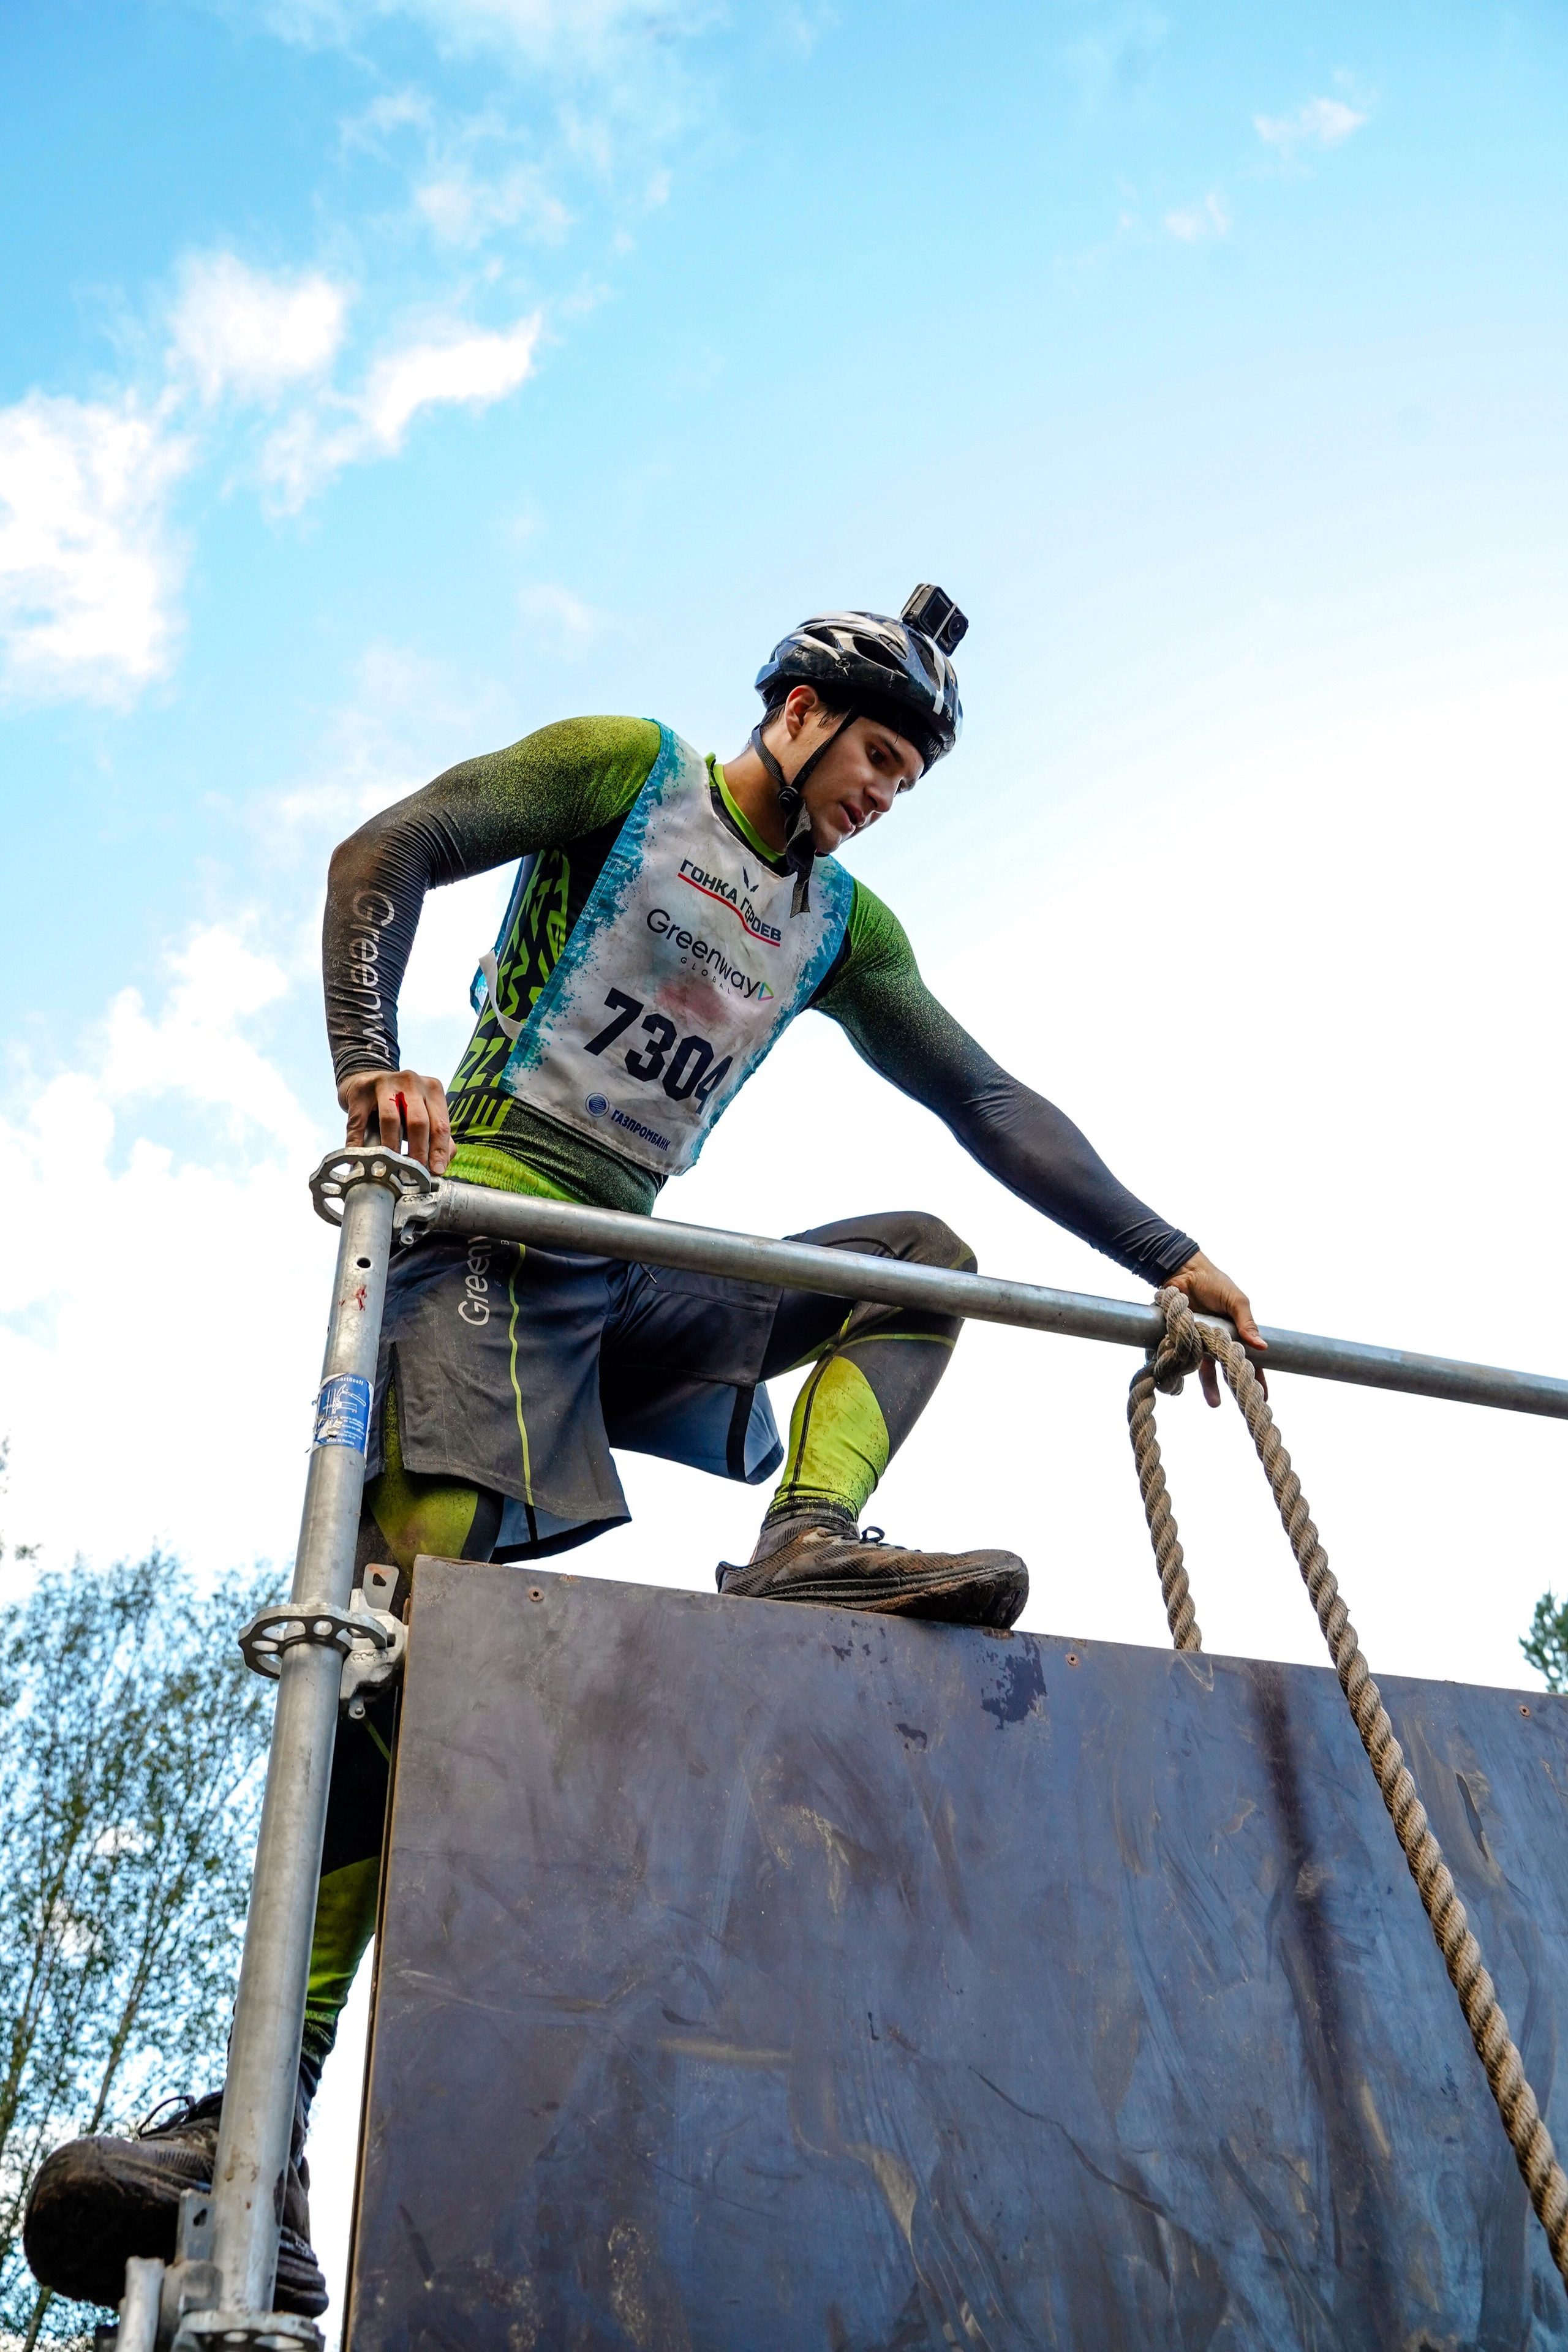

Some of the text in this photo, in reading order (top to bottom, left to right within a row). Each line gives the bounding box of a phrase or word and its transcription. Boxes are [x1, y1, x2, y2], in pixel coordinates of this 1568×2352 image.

[680, 859, 782, 941] ГОНКА ГЕРОЕВ
[646, 908, 761, 998] Greenway
[680, 957, 731, 995] GLOBAL
[583, 987, 733, 1115] 7304
[611, 1109, 671, 1152] ГАЗПРОМБАНК
